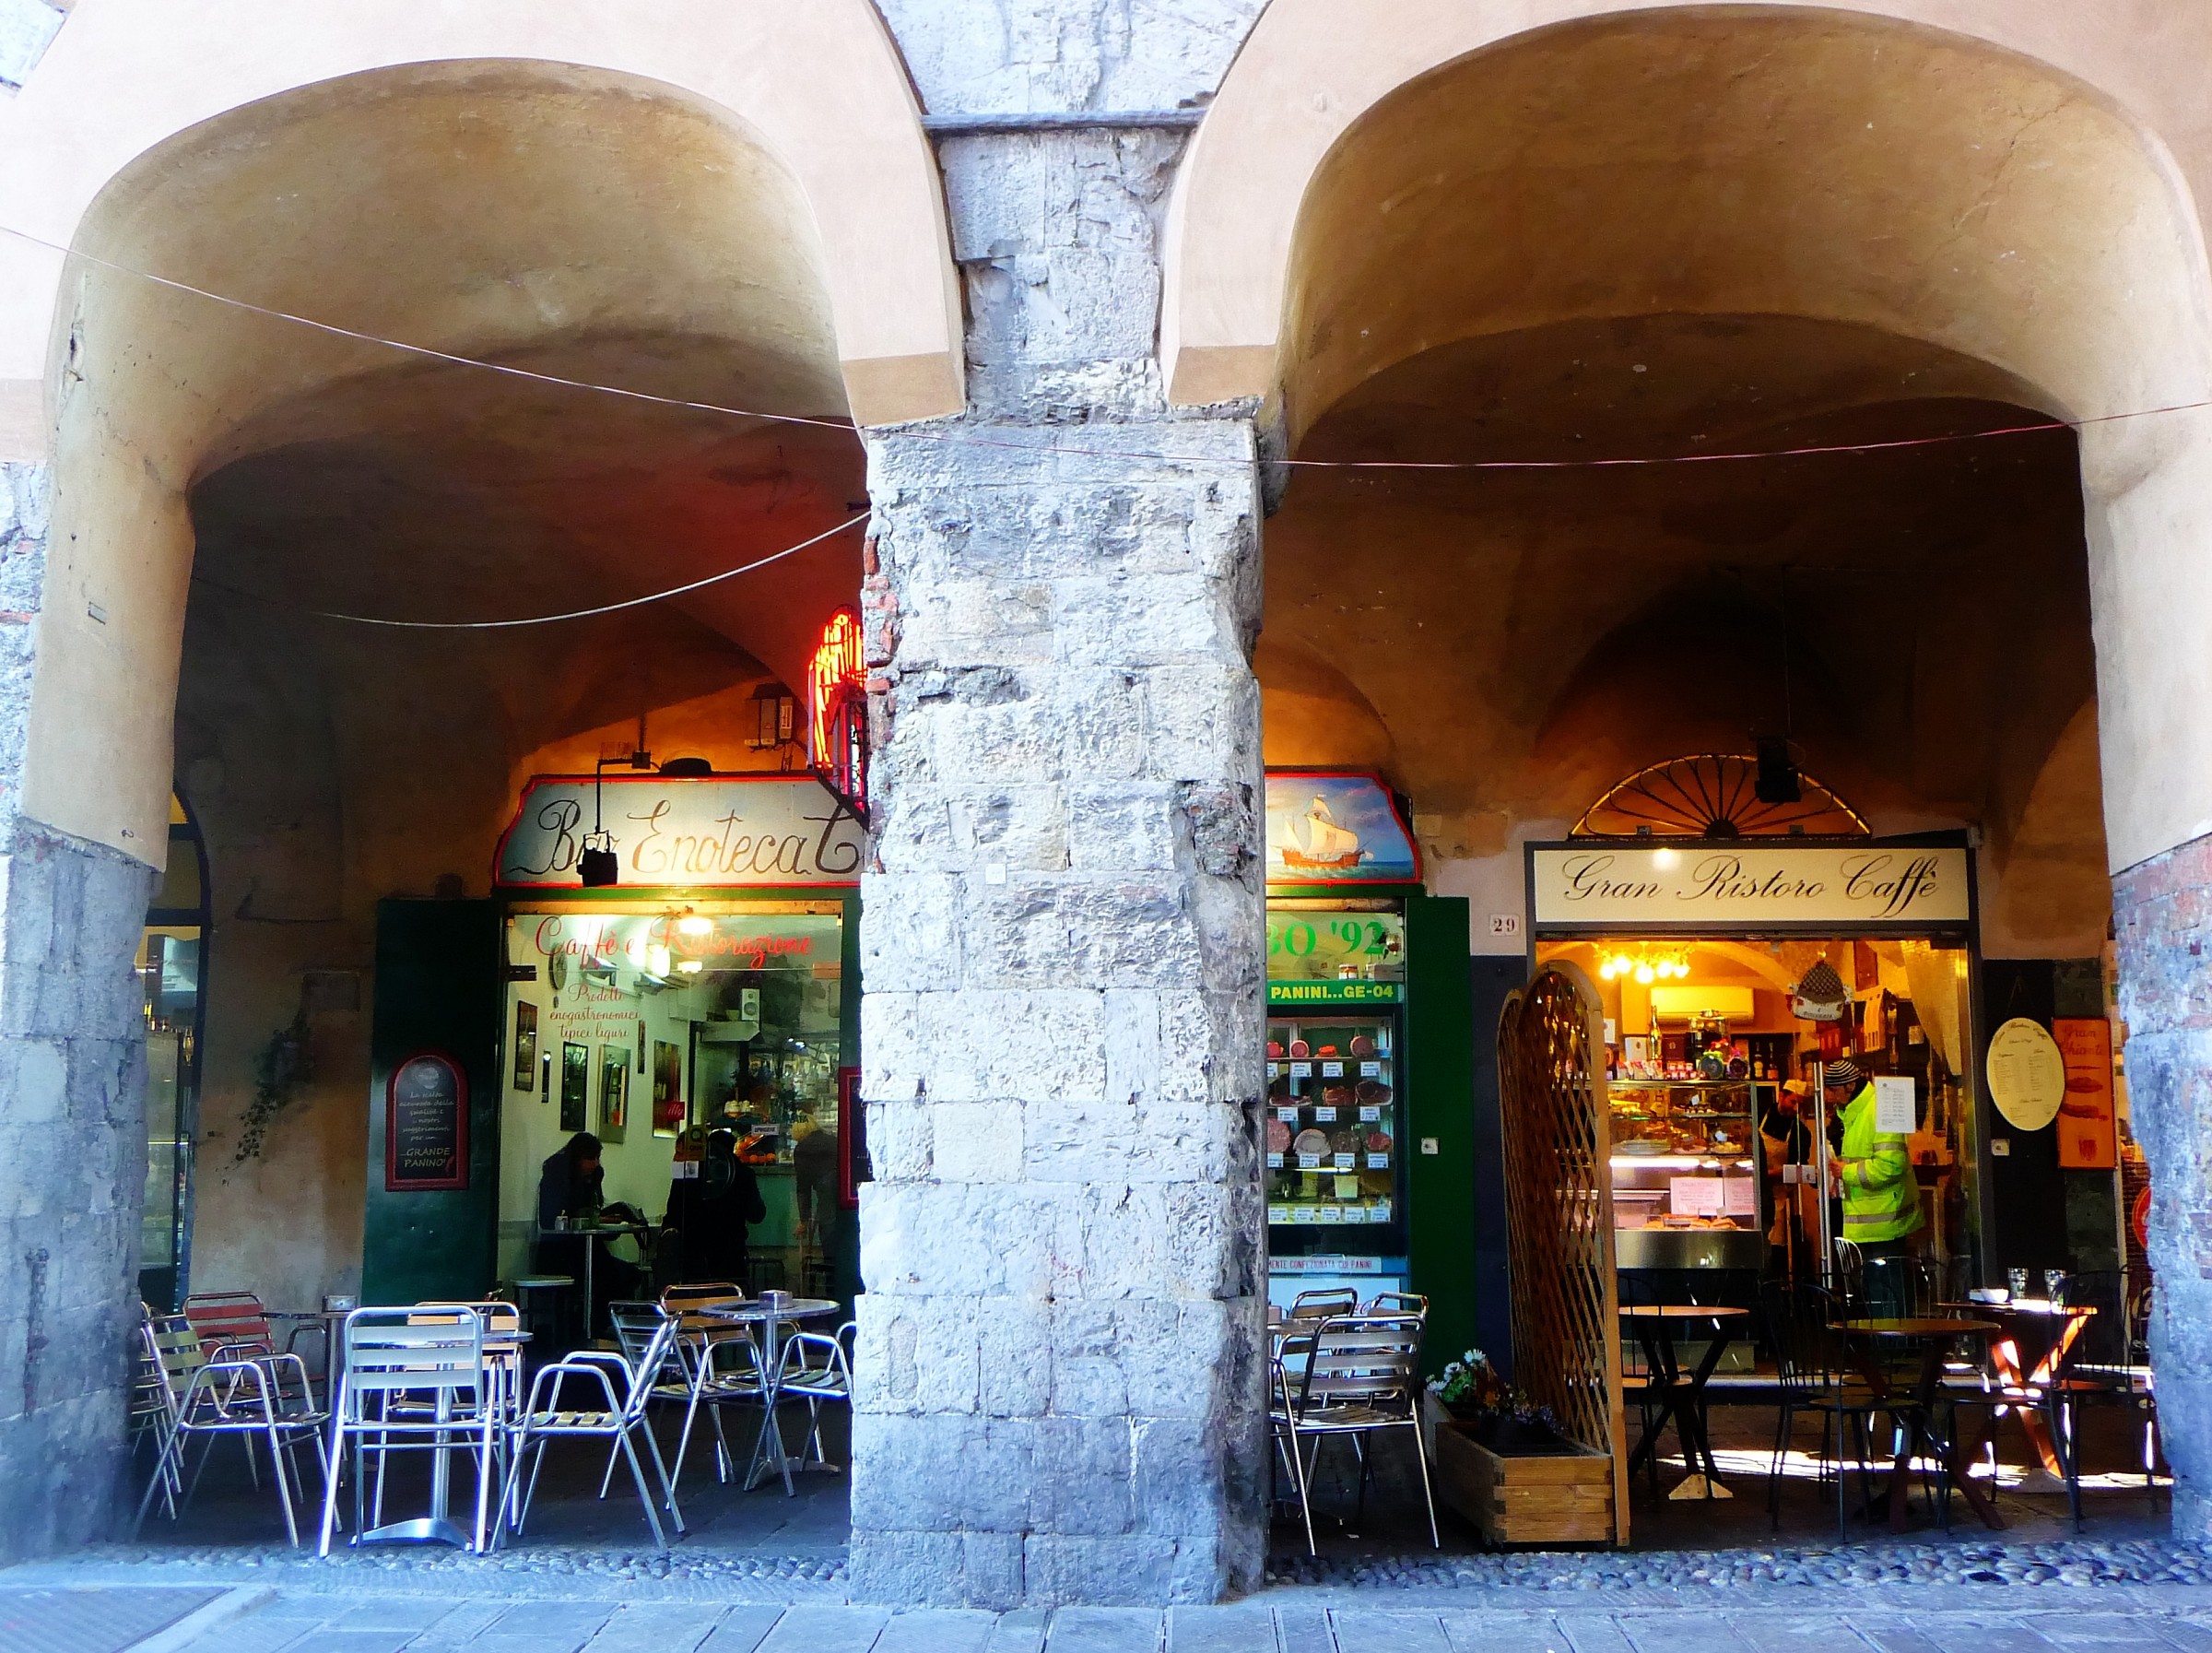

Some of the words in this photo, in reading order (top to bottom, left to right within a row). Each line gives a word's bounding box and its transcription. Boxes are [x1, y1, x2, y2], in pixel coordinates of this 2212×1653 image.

[627, 799, 812, 875] Enoteca
[1562, 855, 1664, 901] Gran
[1676, 855, 1827, 901] Ristoro
[1840, 854, 1939, 918] Caffè
[1330, 921, 1385, 956] '92
[1493, 917, 1515, 932] 29
[535, 915, 619, 970] Caffè
[568, 983, 623, 1002] Prodotti
[549, 1006, 641, 1027] enogastronomici
[558, 1023, 592, 1041] tipici
[595, 1021, 629, 1043] liguri
